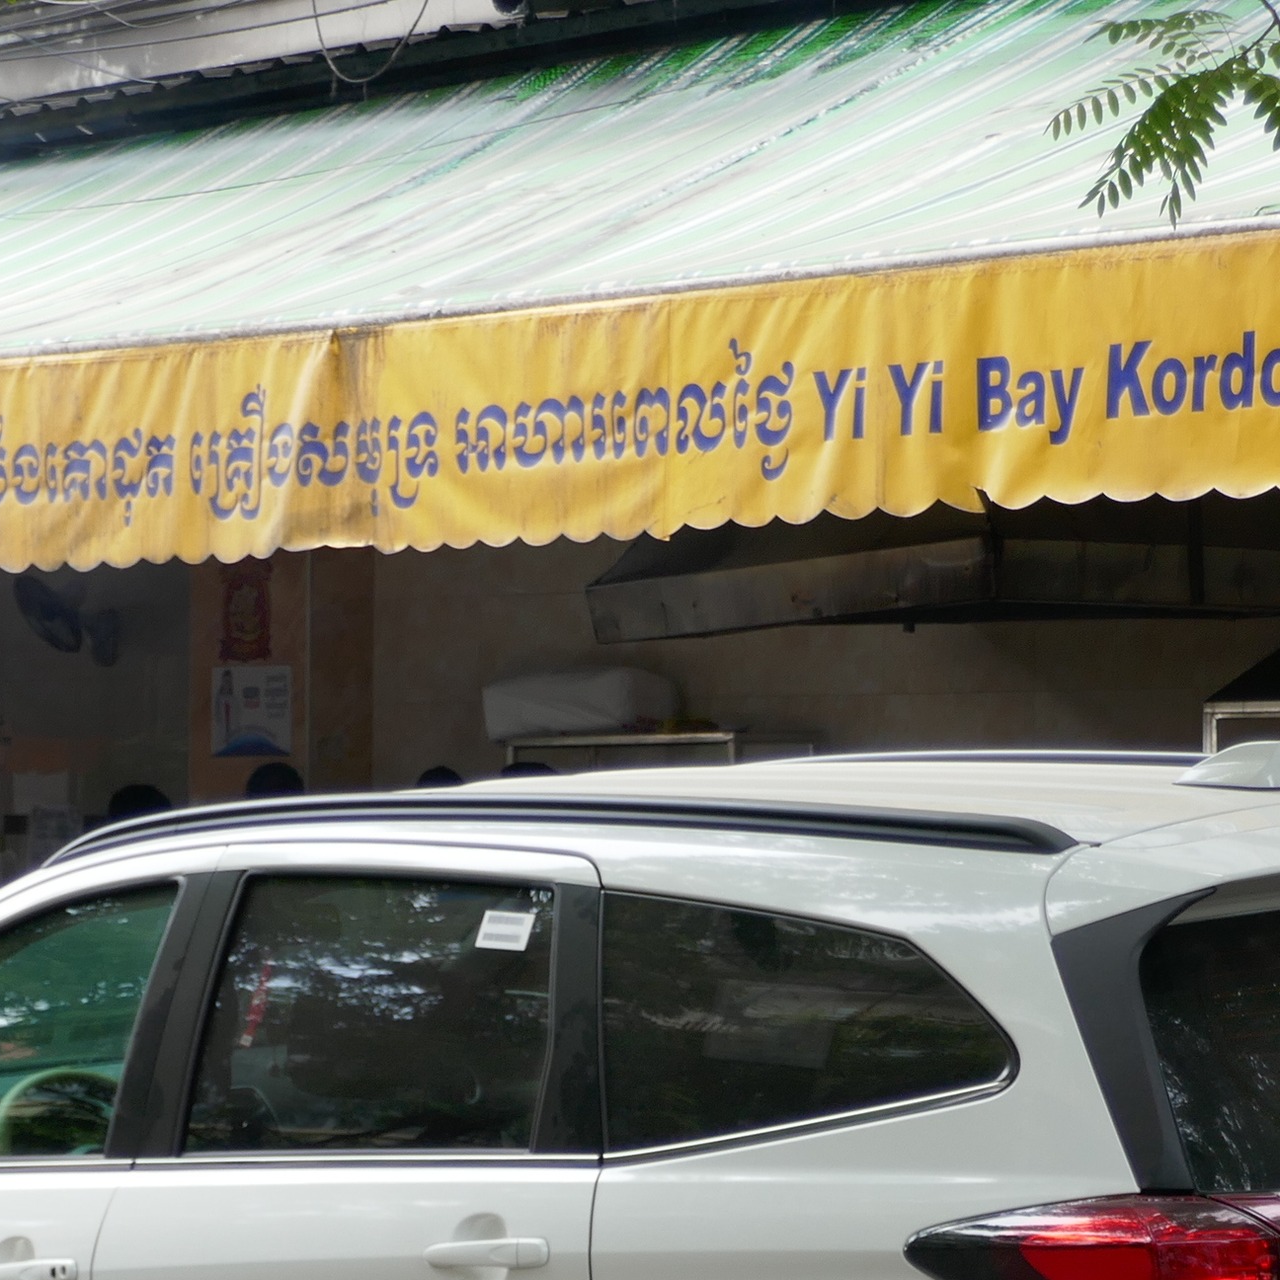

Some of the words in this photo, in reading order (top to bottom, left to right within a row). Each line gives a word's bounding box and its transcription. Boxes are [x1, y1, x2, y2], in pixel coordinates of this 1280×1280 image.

[814, 366, 867, 442] Yi
[888, 360, 944, 437] Yi
[976, 355, 1084, 446] Bay
